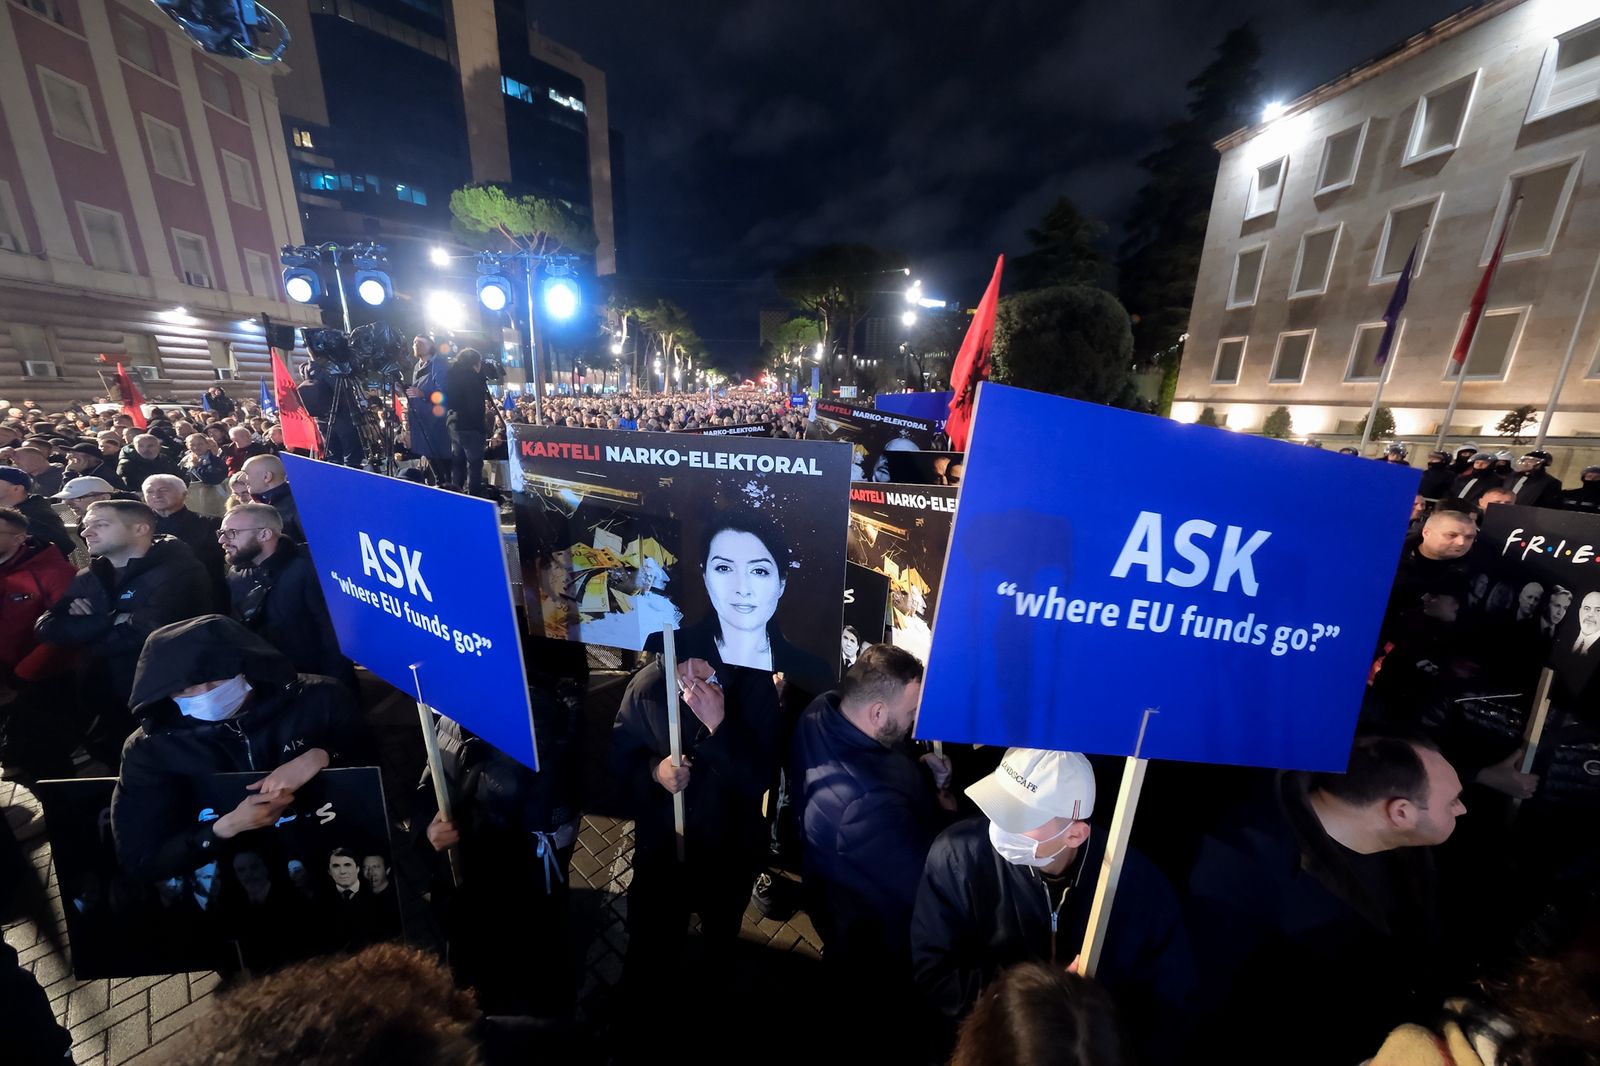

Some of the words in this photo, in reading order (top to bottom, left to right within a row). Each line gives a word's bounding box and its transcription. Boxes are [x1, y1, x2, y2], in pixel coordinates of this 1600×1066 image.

[818, 403, 851, 415] KARTELI
[852, 410, 928, 430] NARKO-ELEKTORAL
[521, 441, 600, 461] KARTELI
[605, 445, 823, 476] NARKO-ELEKTORAL
[849, 489, 885, 504] KARTELI
[886, 492, 959, 513] NARKO-ELE
[358, 531, 433, 602] ASK
[1109, 510, 1273, 597] ASK
[331, 570, 380, 608] “where
[380, 591, 401, 618] EU
[404, 601, 450, 641] funds
[453, 629, 492, 657] go?”
[997, 581, 1120, 627] “where
[1127, 599, 1175, 633] EU
[1179, 604, 1268, 646] funds
[1270, 622, 1341, 657] go?”
